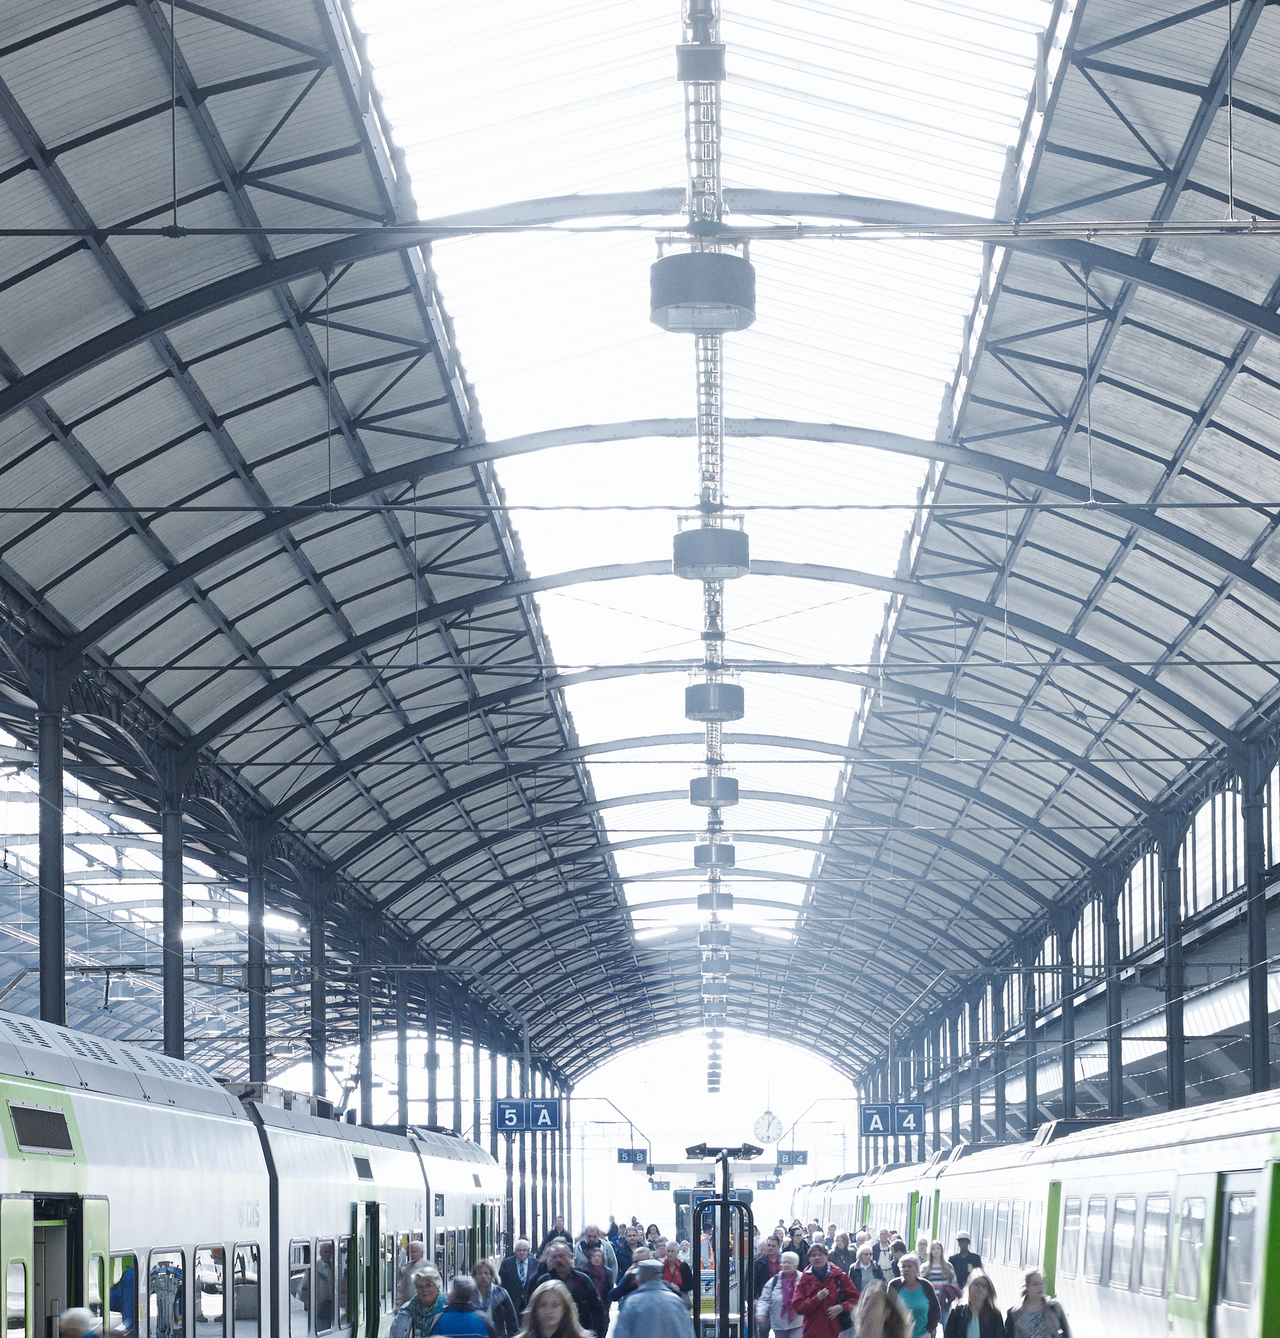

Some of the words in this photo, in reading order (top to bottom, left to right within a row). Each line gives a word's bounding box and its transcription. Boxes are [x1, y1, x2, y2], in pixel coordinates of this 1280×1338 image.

[504, 1109, 518, 1126] 5
[537, 1108, 552, 1126] A
[869, 1114, 884, 1131] A
[902, 1113, 917, 1130] 4
[622, 1153, 628, 1161] 5
[636, 1153, 643, 1161] B
[782, 1154, 789, 1163] B
[796, 1155, 804, 1163] 4
